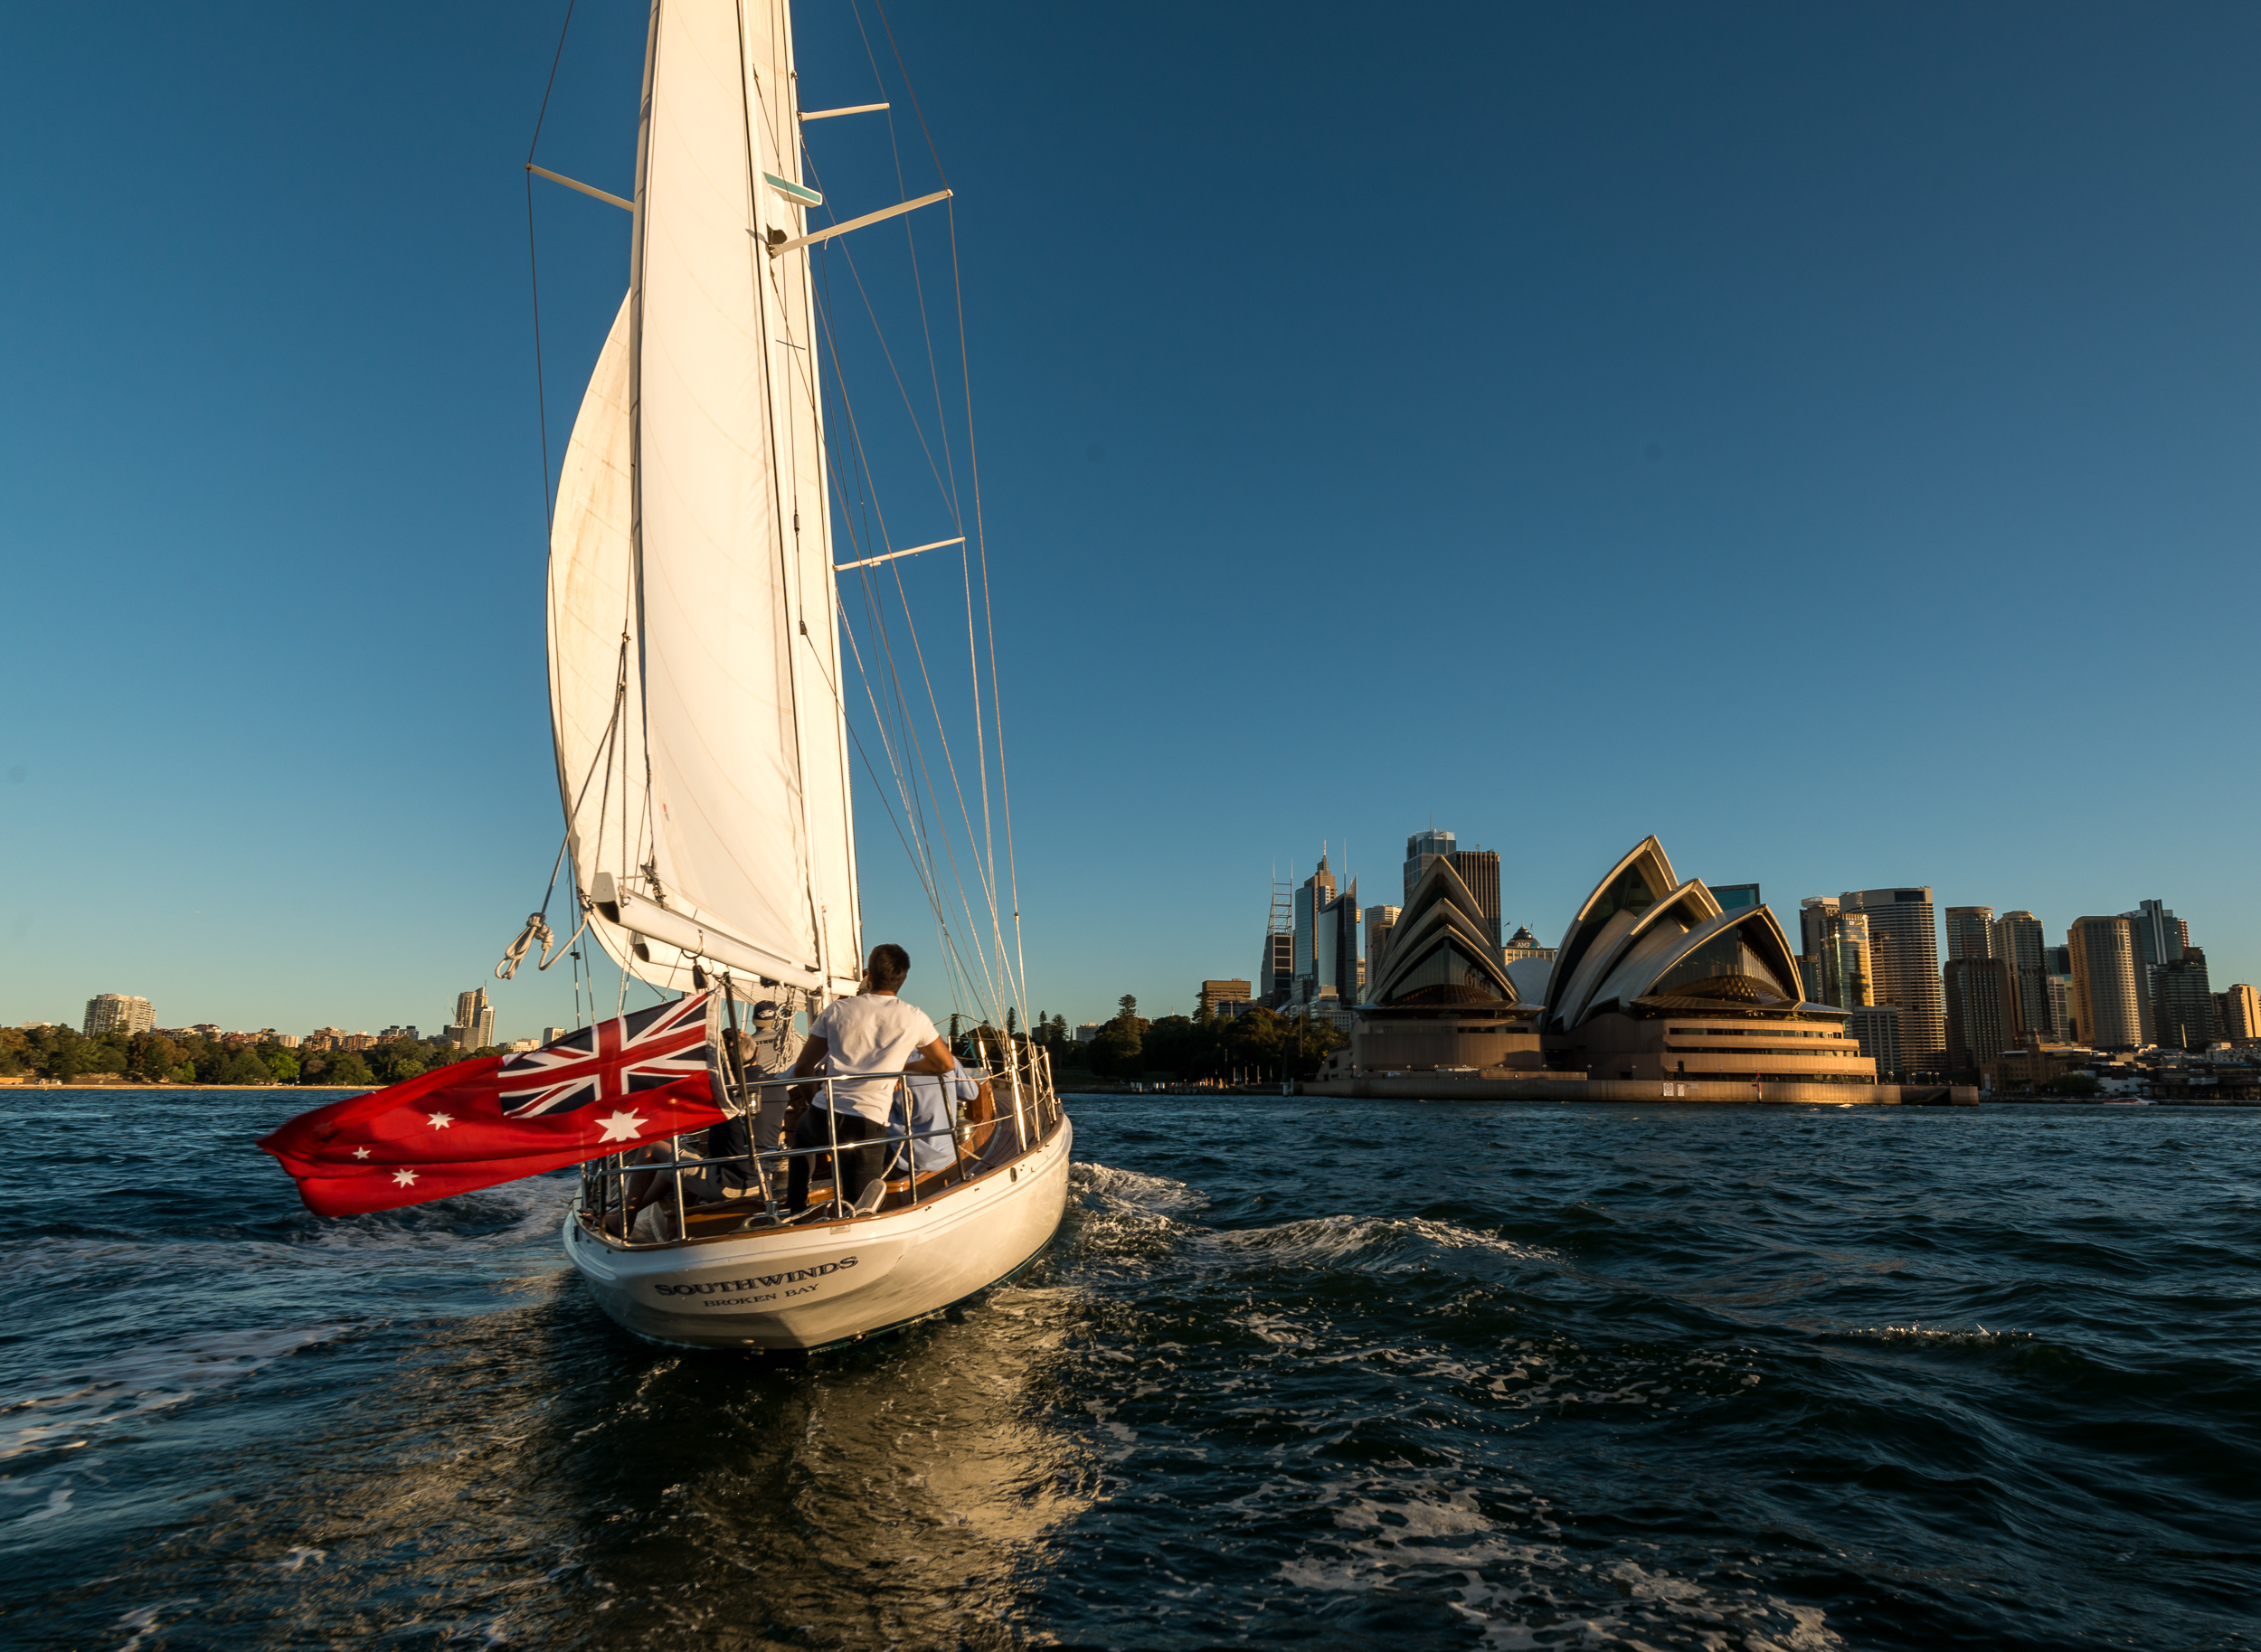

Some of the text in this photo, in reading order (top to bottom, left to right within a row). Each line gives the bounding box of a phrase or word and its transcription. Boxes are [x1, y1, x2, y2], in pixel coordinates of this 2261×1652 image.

[654, 1255, 859, 1296] SOUTHWINDS
[704, 1283, 819, 1307] BROKEN BAY
